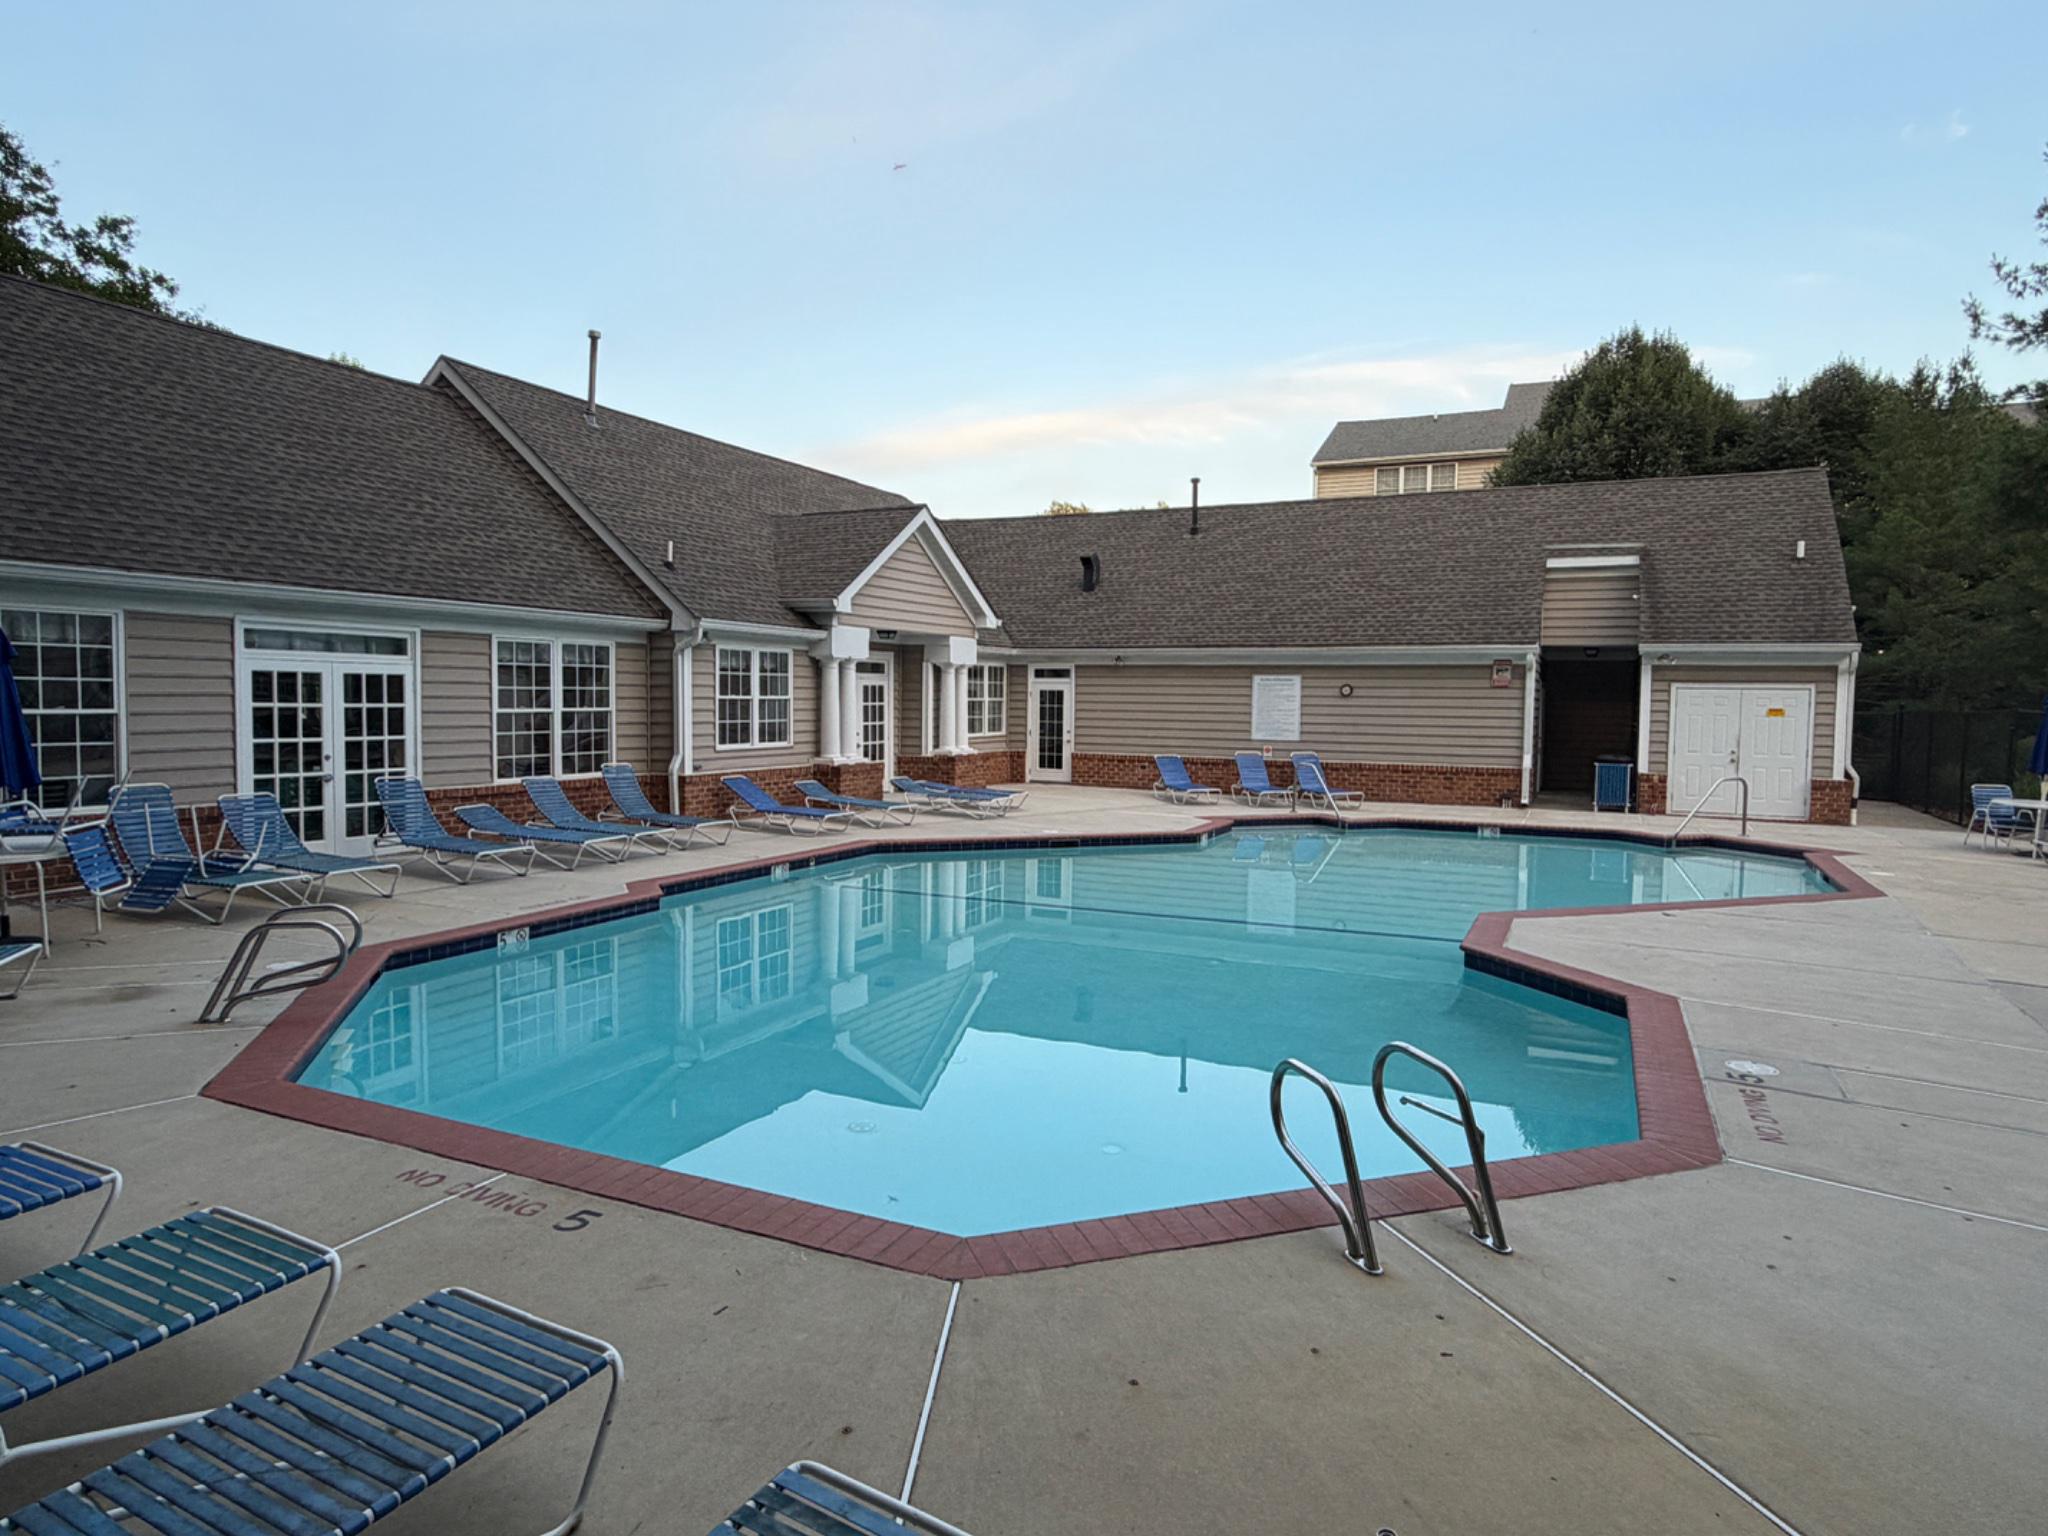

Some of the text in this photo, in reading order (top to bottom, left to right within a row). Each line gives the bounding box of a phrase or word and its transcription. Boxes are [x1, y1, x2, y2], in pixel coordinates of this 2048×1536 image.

[1754, 1126, 1788, 1145] NO
[395, 1169, 447, 1187] NO
[552, 1209, 603, 1232] 5
